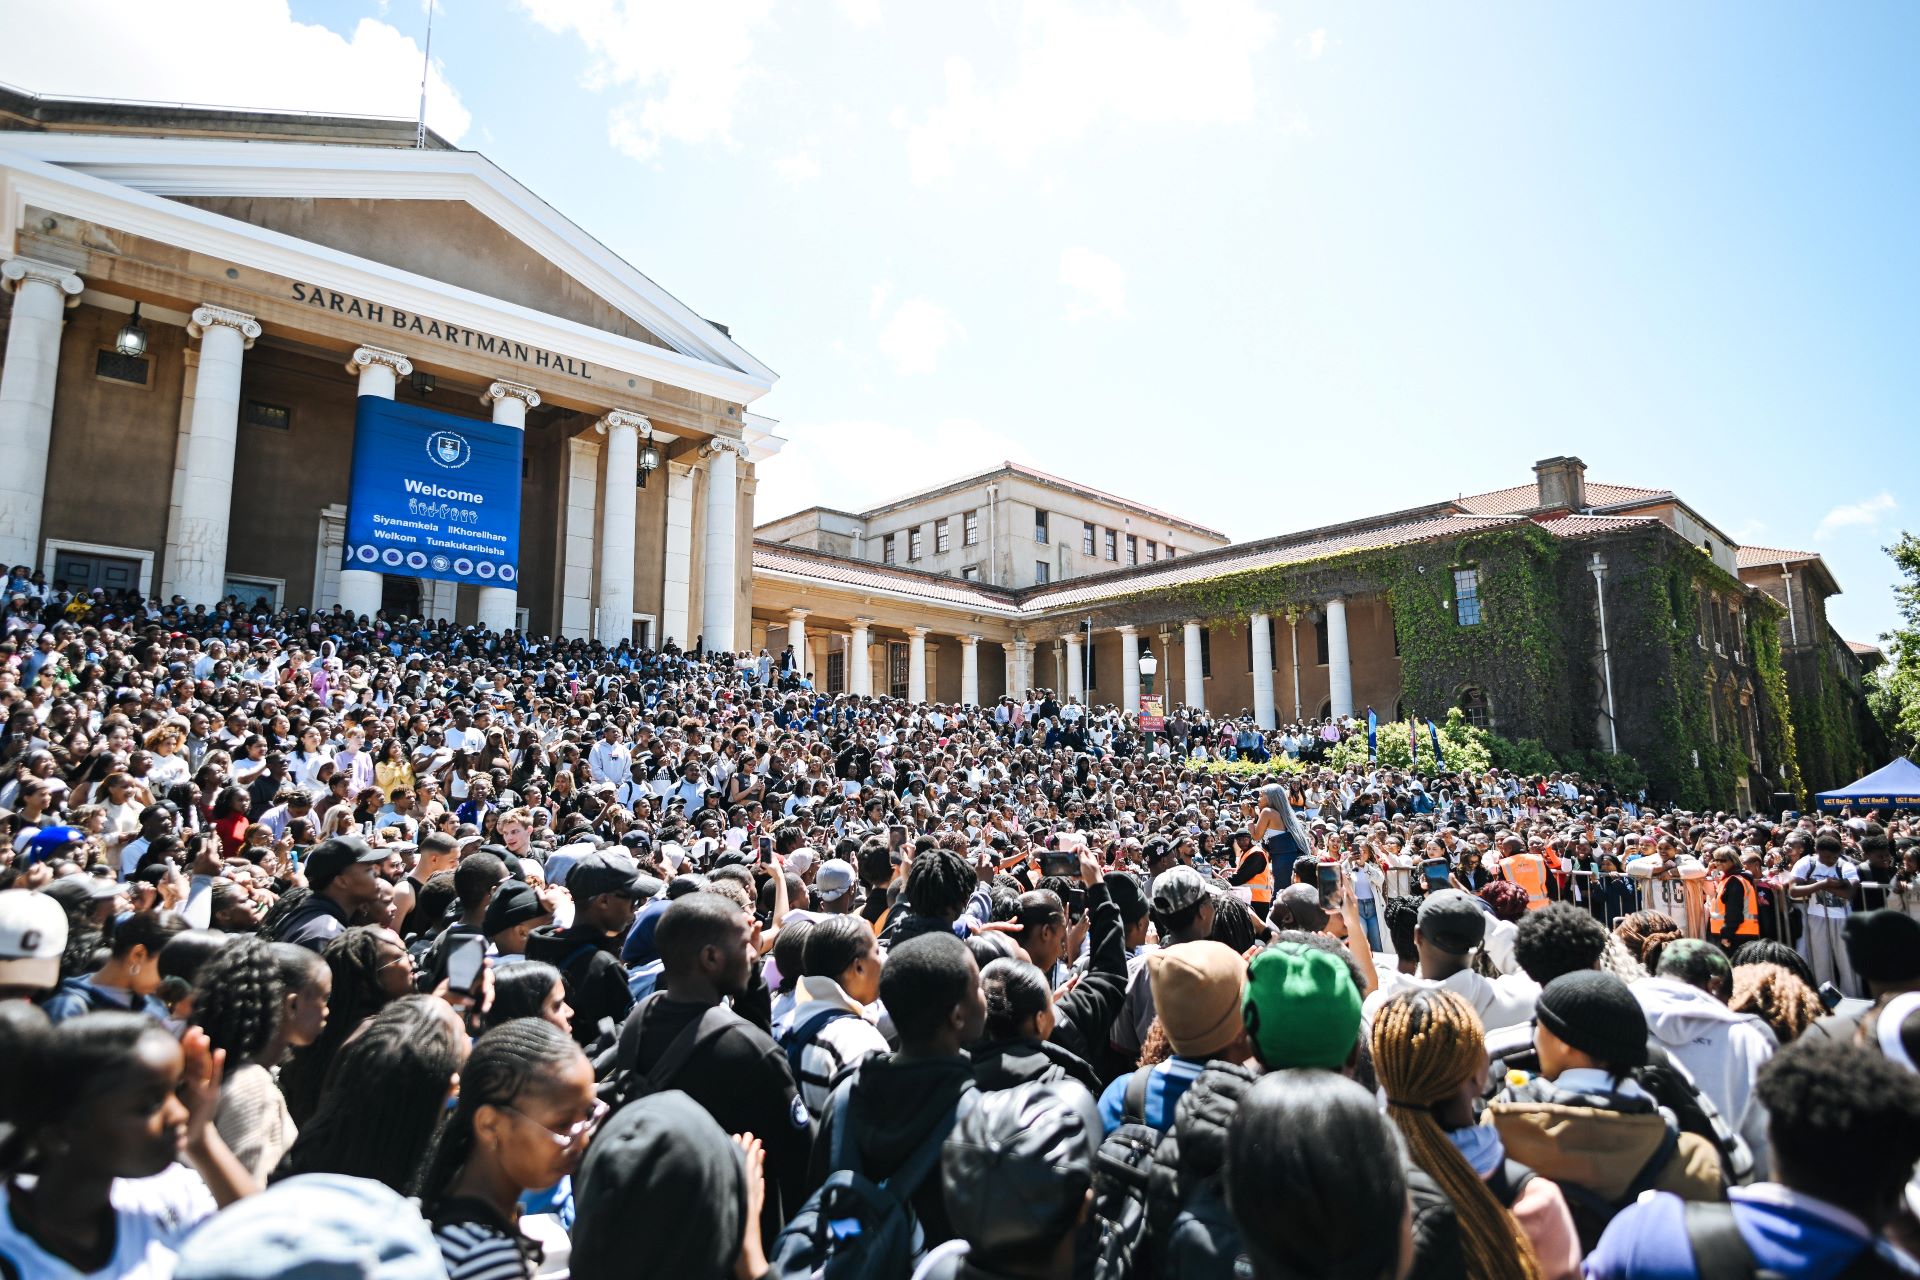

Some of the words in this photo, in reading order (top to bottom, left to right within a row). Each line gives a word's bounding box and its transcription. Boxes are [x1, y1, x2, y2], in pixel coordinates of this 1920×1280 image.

[292, 282, 383, 323] SARAH
[392, 309, 528, 362] BAARTMAN
[536, 349, 592, 379] HALL
[404, 478, 484, 504] Welcome
[373, 514, 439, 532] Siyanamkela
[374, 529, 417, 543] Welkom
[426, 536, 505, 556] Tunakukaribisha
